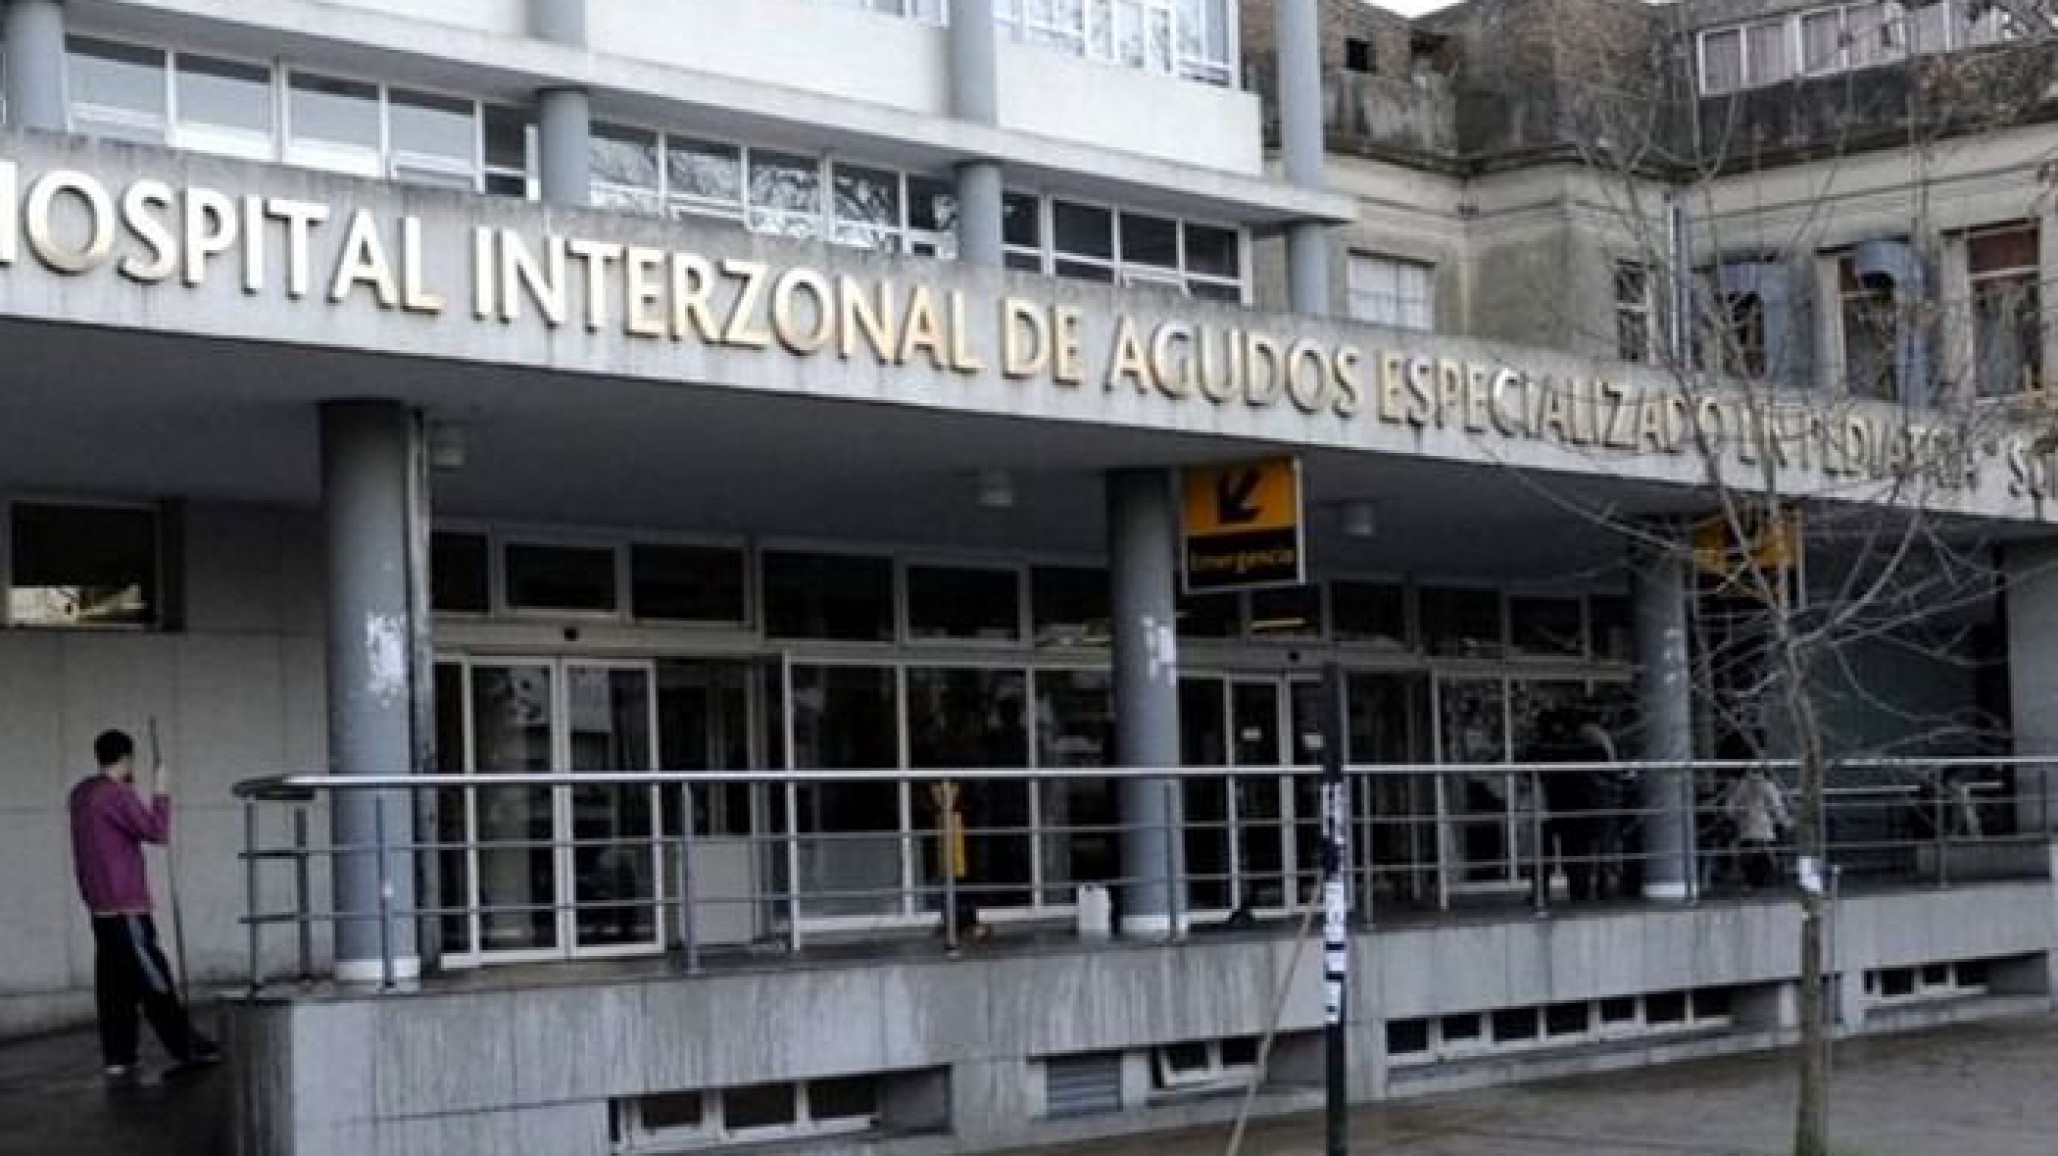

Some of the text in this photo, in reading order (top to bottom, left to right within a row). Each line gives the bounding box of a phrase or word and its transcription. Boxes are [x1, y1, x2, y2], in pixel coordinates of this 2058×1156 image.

[473, 226, 980, 372] INTERZONAL
[1001, 297, 1085, 384] DE
[1104, 315, 1362, 418] AGUDOS
[1376, 350, 1723, 456] ESPECIALIZADO
